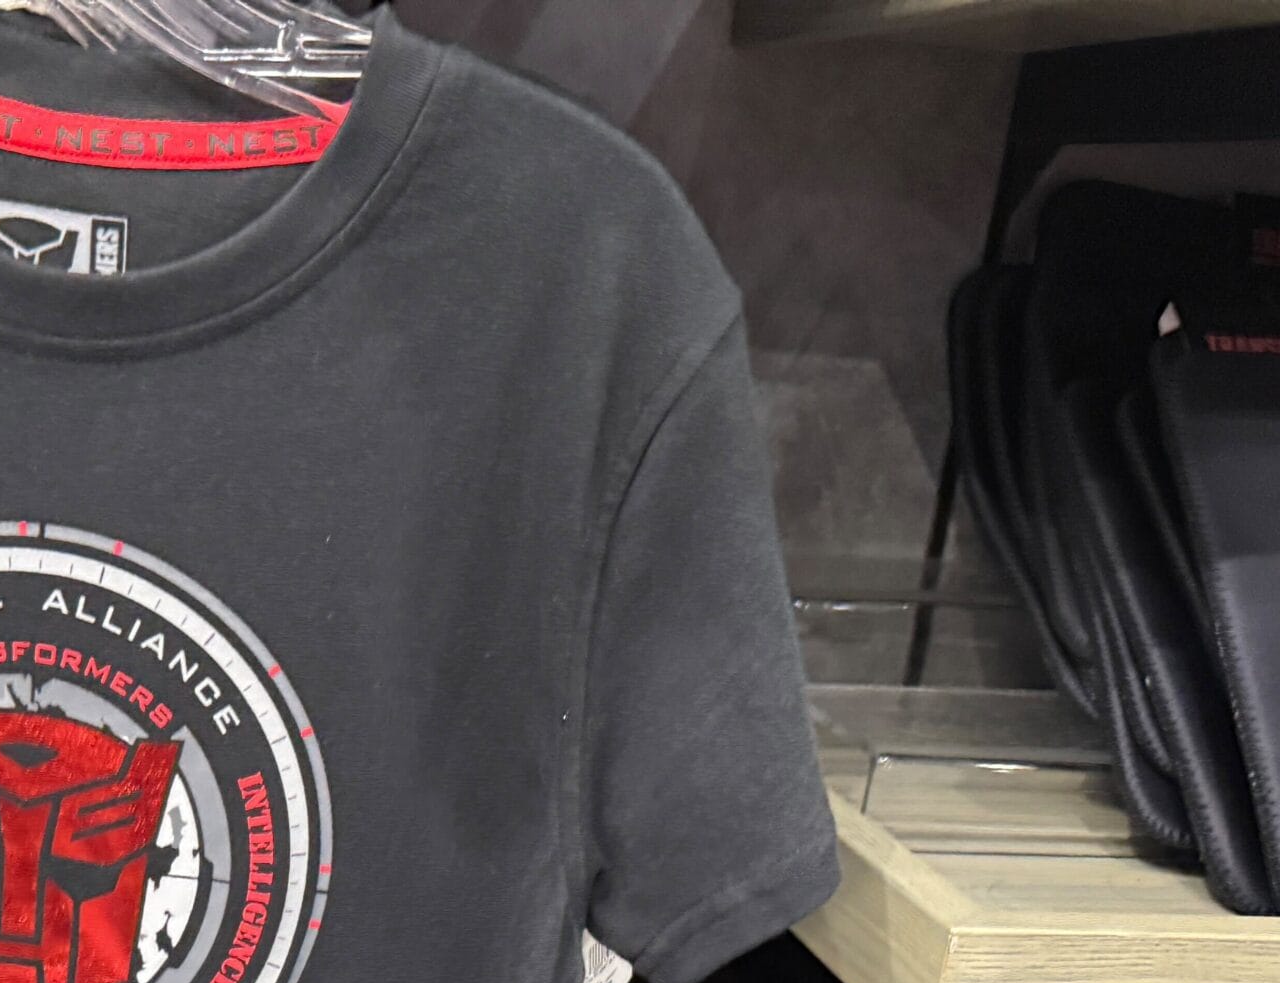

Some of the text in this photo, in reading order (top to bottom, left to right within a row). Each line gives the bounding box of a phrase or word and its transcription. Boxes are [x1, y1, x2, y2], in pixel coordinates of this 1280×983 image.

[55, 125, 171, 157] NEST
[207, 124, 324, 158] NEST
[41, 588, 241, 736] ALLIANCE
